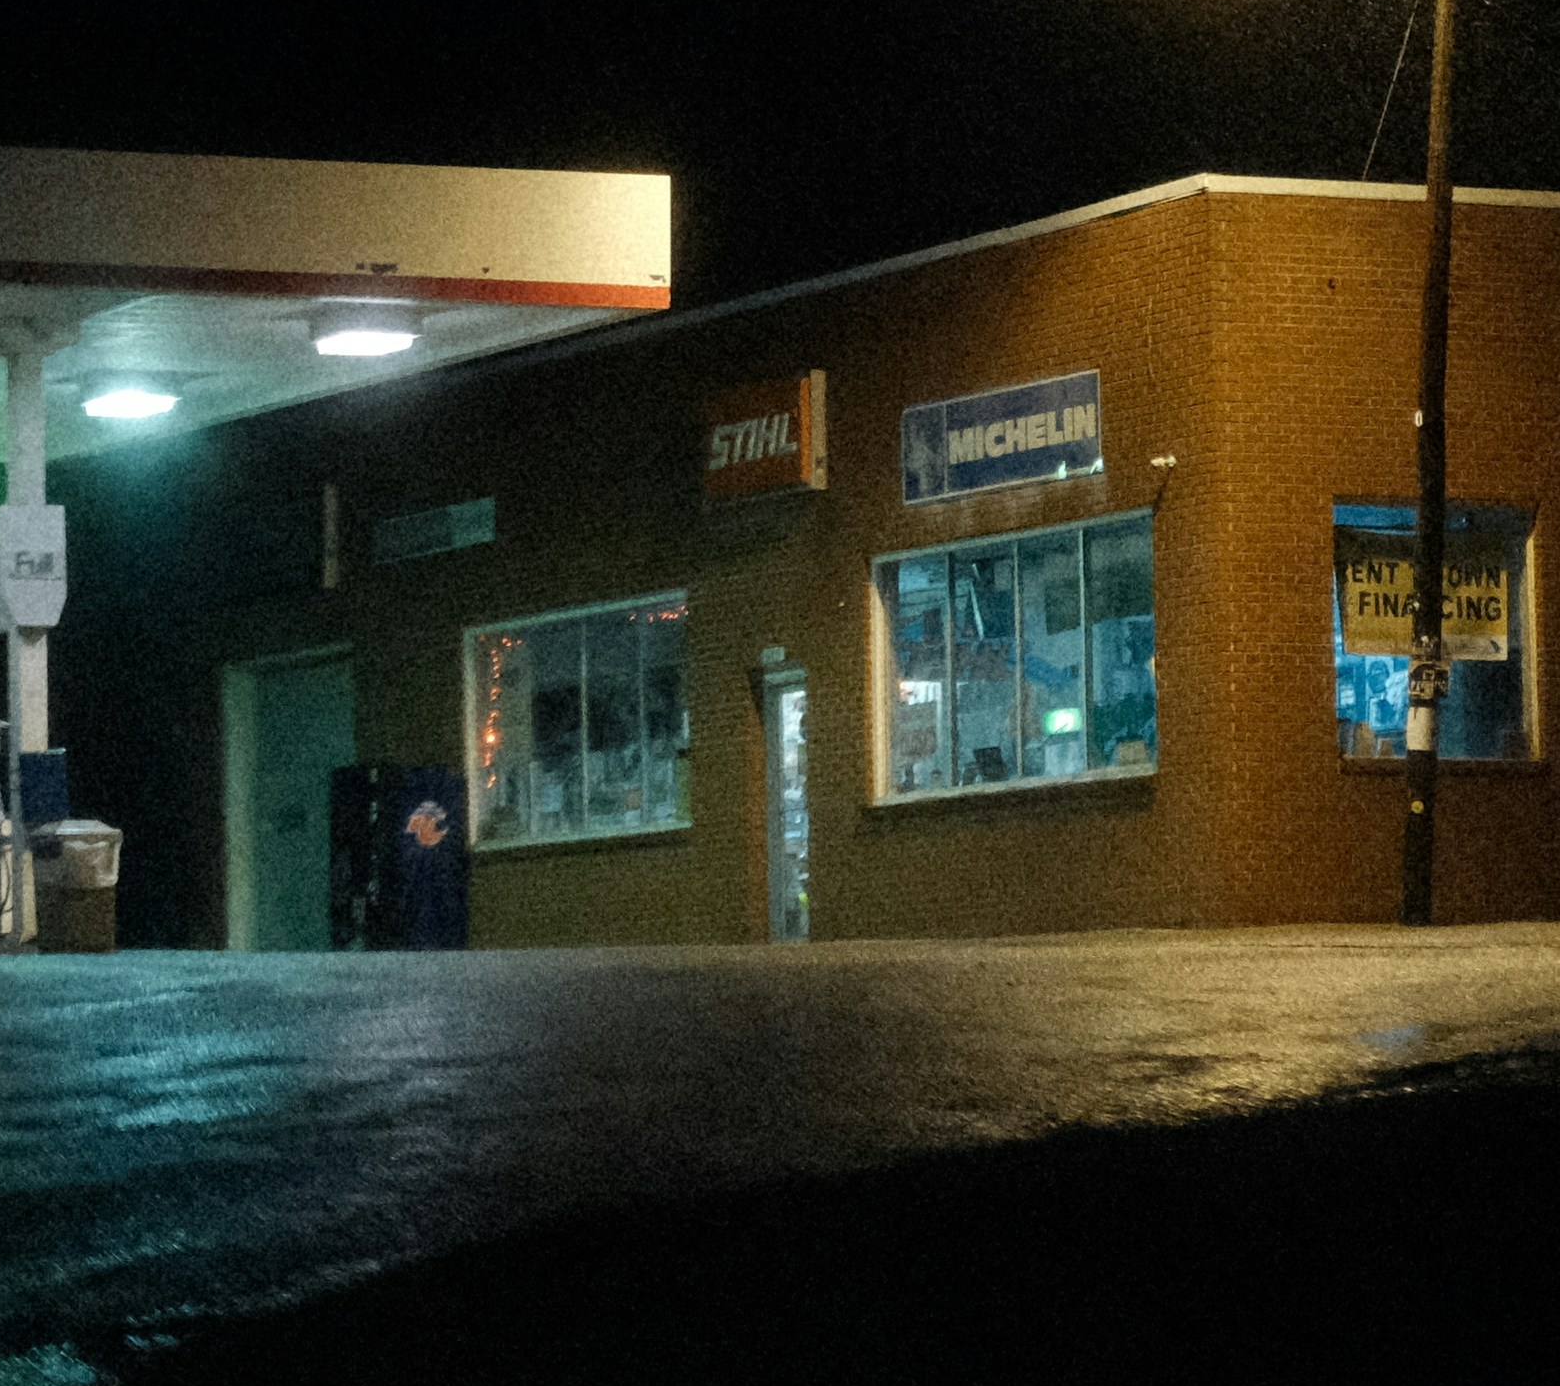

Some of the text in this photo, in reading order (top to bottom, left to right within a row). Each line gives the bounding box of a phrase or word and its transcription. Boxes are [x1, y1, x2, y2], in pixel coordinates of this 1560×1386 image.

[708, 412, 798, 470] STIHL
[947, 402, 1097, 465] MICHELIN
[1447, 564, 1501, 588] OWN
[1358, 592, 1502, 621] FINACING
